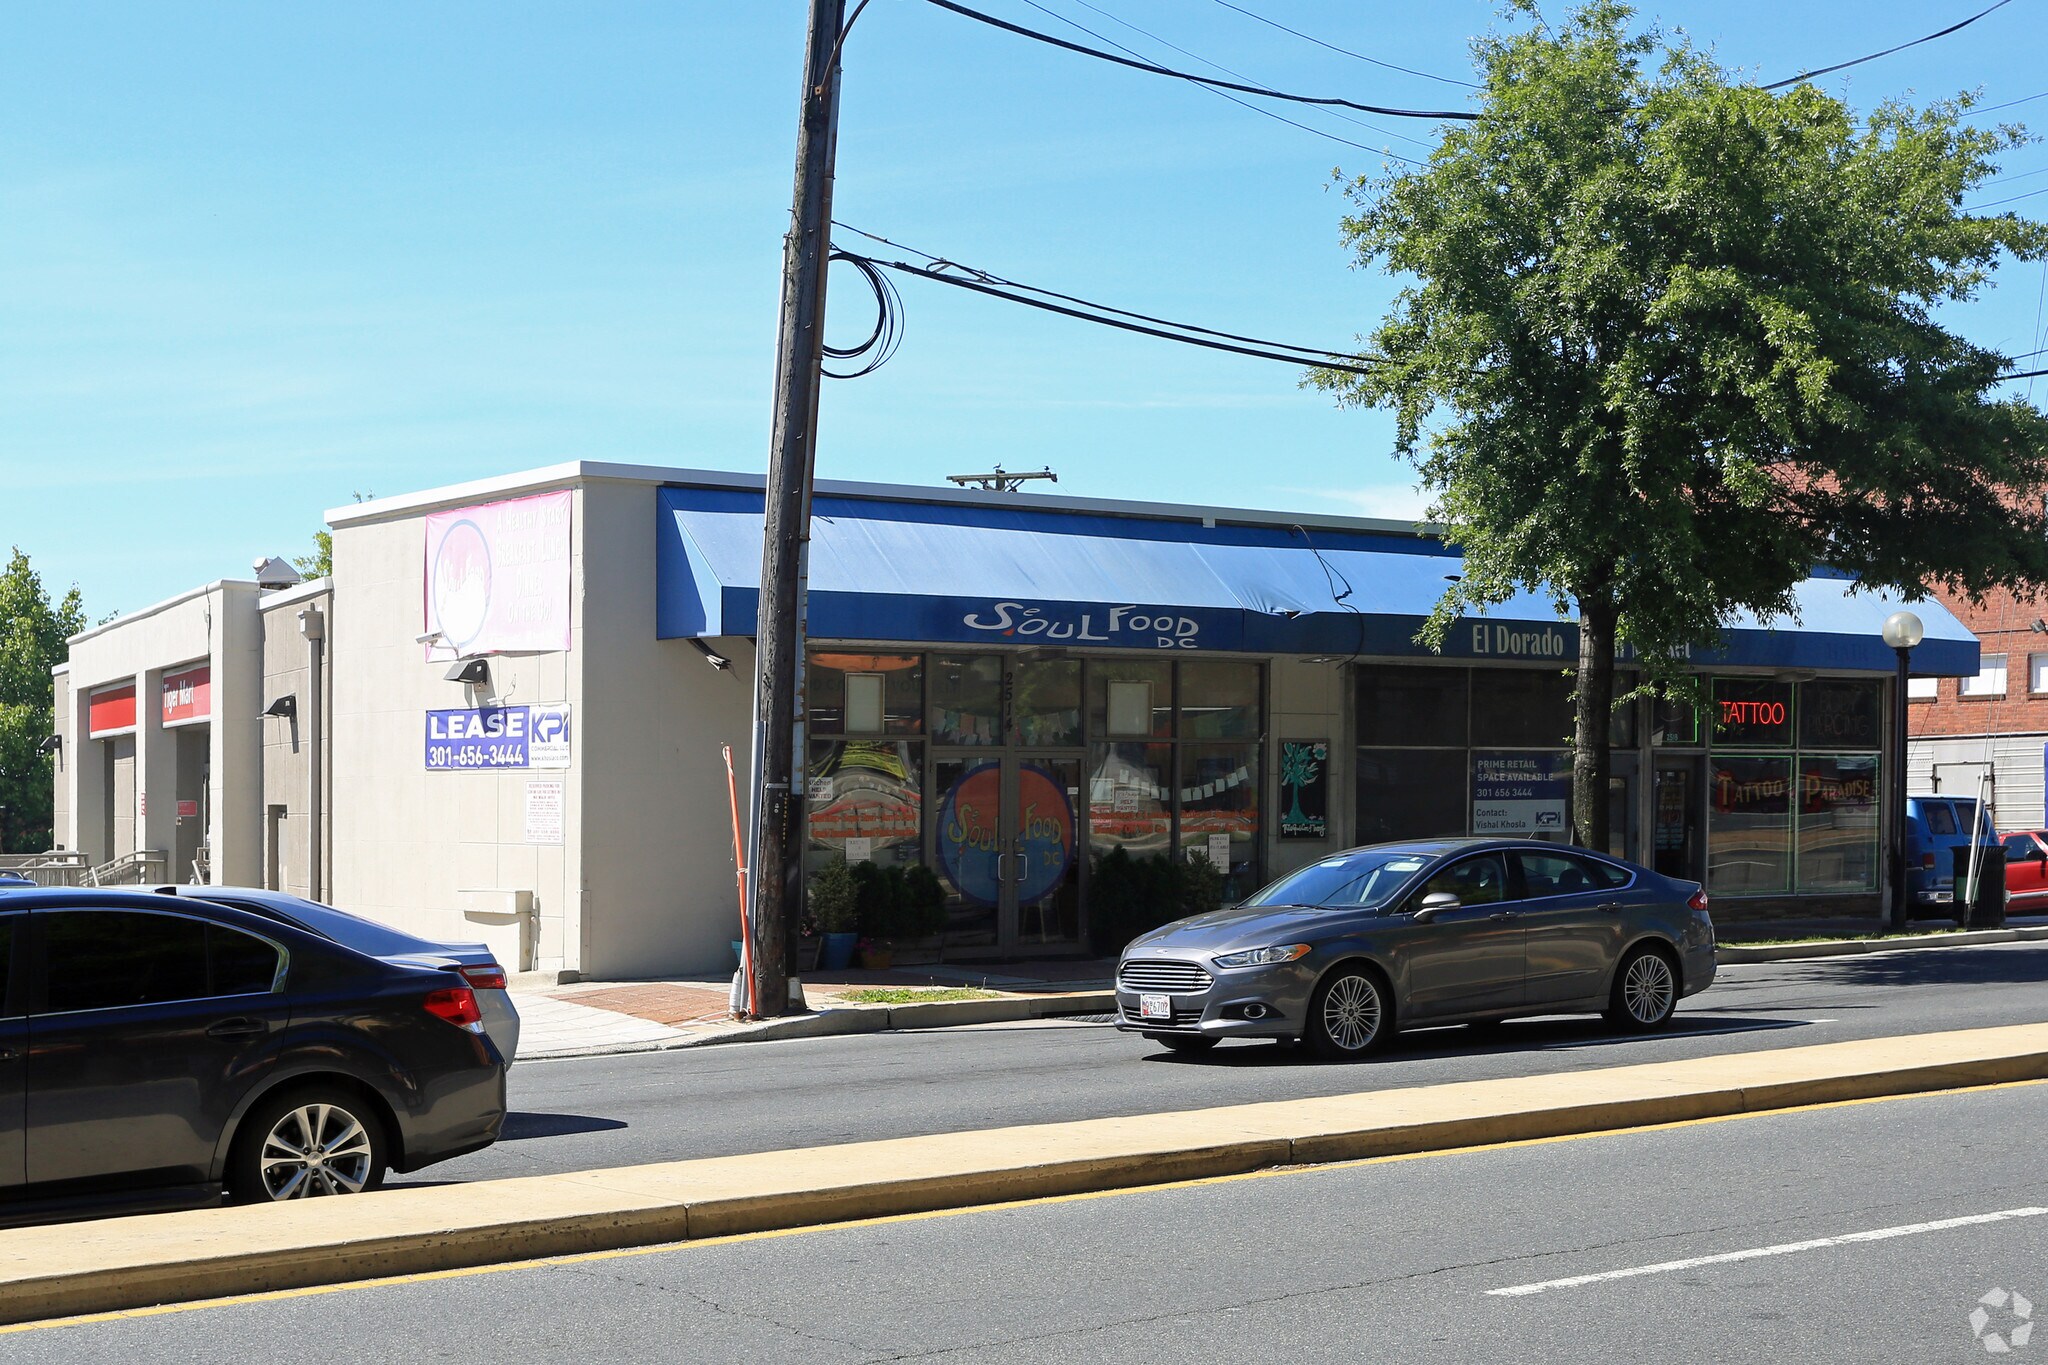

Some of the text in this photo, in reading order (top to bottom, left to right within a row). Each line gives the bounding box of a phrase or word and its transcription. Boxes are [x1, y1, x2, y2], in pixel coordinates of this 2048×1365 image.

[506, 505, 538, 532] HEALTHY
[540, 503, 566, 528] START
[1108, 604, 1200, 638] FOOD
[1157, 636, 1199, 650] DC
[1472, 624, 1490, 654] El
[1496, 625, 1564, 657] Dorado
[164, 680, 194, 714] Tiger Mart
[1719, 700, 1785, 726] TATTOO
[430, 711, 525, 740] LEASE
[428, 744, 524, 767] 301-656-3444
[1477, 759, 1537, 769] PRIME RETAIL
[1477, 772, 1554, 782] SPACE AVAILABLE
[1476, 788, 1533, 797] 301 656 3444
[1476, 808, 1508, 817] Contact:
[1476, 820, 1526, 829] Vishal Khosla
